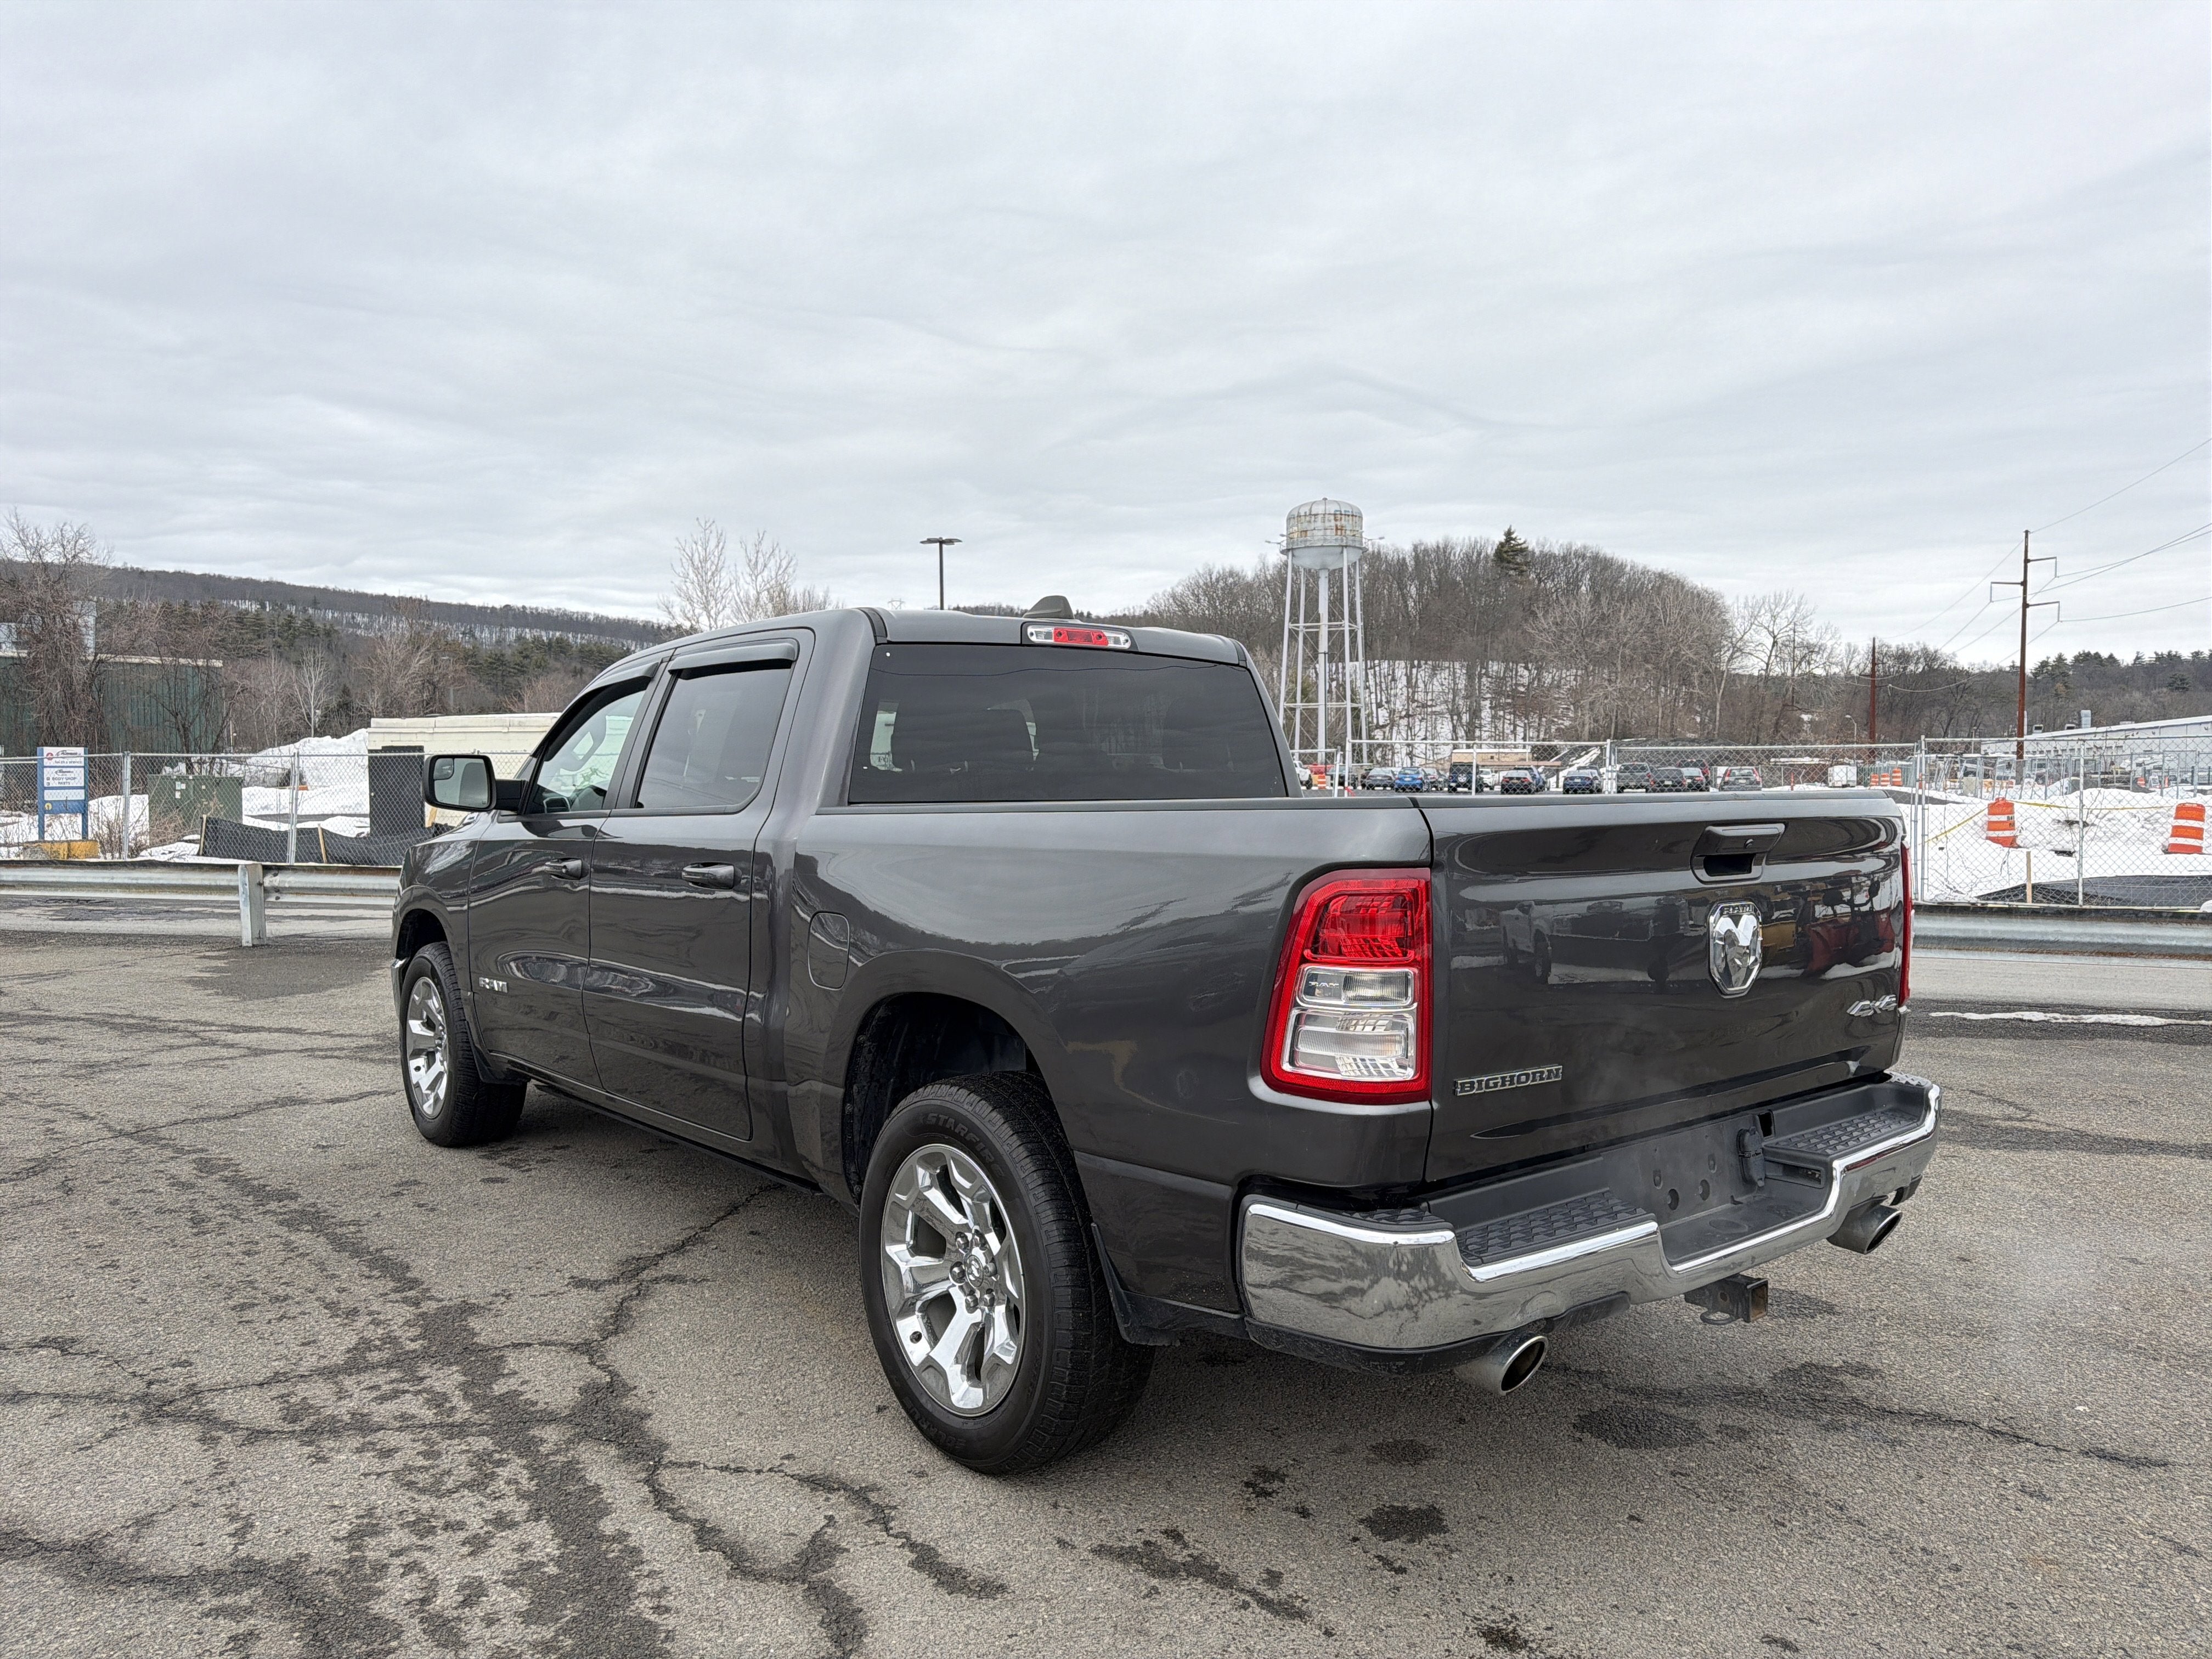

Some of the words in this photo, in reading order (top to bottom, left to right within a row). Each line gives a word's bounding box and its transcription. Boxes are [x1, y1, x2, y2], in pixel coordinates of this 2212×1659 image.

[1723, 904, 1753, 915] RAM
[479, 977, 508, 994] RAM
[1455, 1065, 1563, 1096] BIGHORN
[924, 1112, 1007, 1178] STARFIRE
